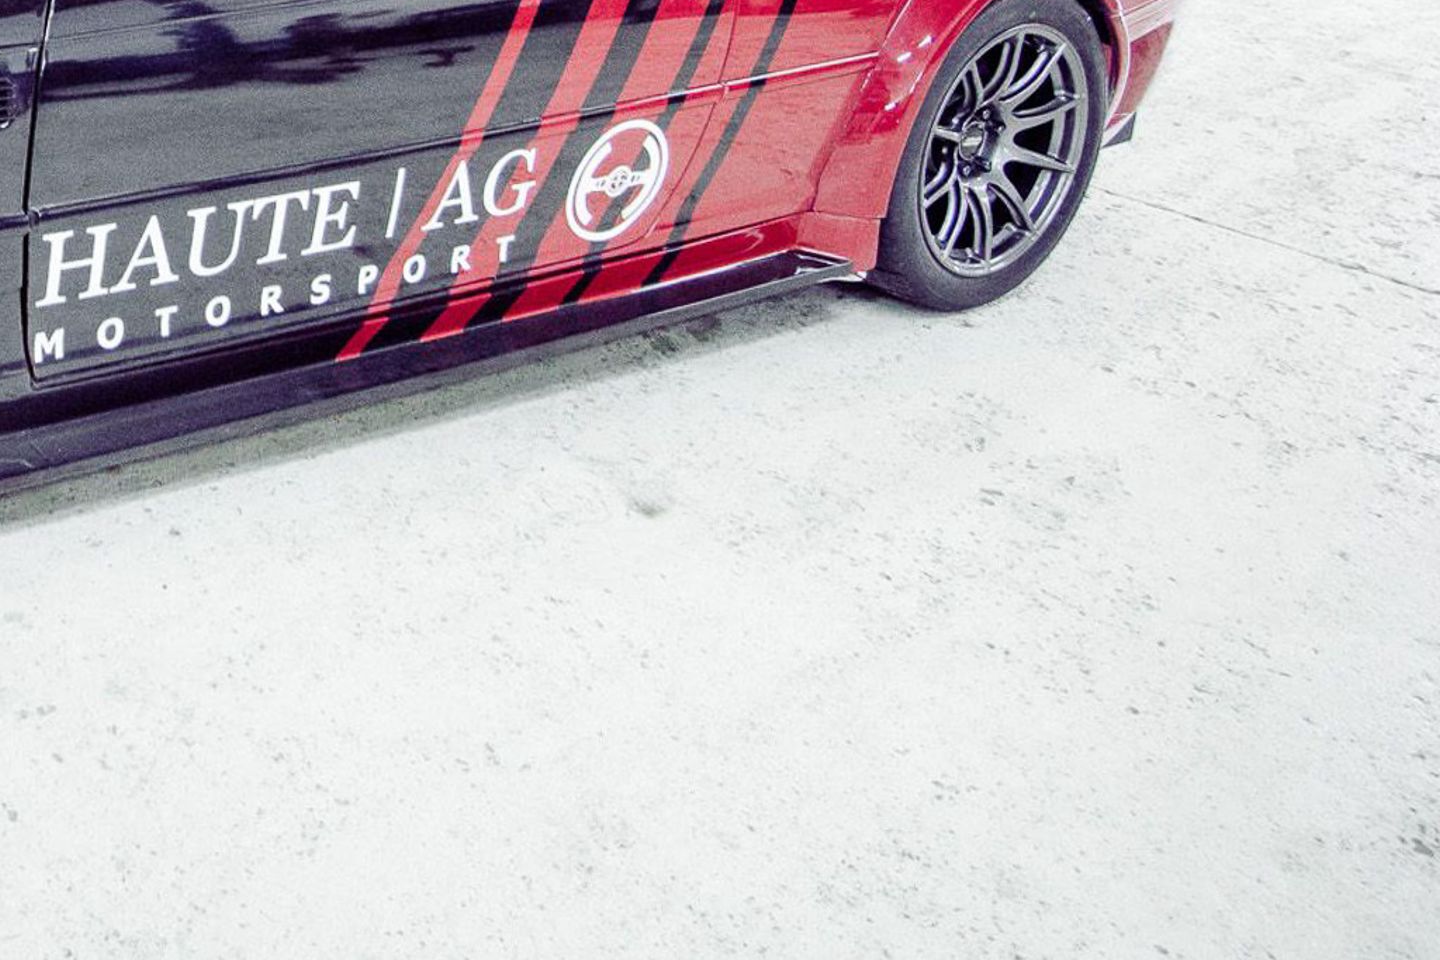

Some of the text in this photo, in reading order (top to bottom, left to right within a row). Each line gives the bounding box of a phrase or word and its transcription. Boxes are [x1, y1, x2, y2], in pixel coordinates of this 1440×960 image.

[34, 234, 516, 364] MOTORSPORT
[35, 181, 360, 308] HAUTE
[421, 148, 537, 232] AG
